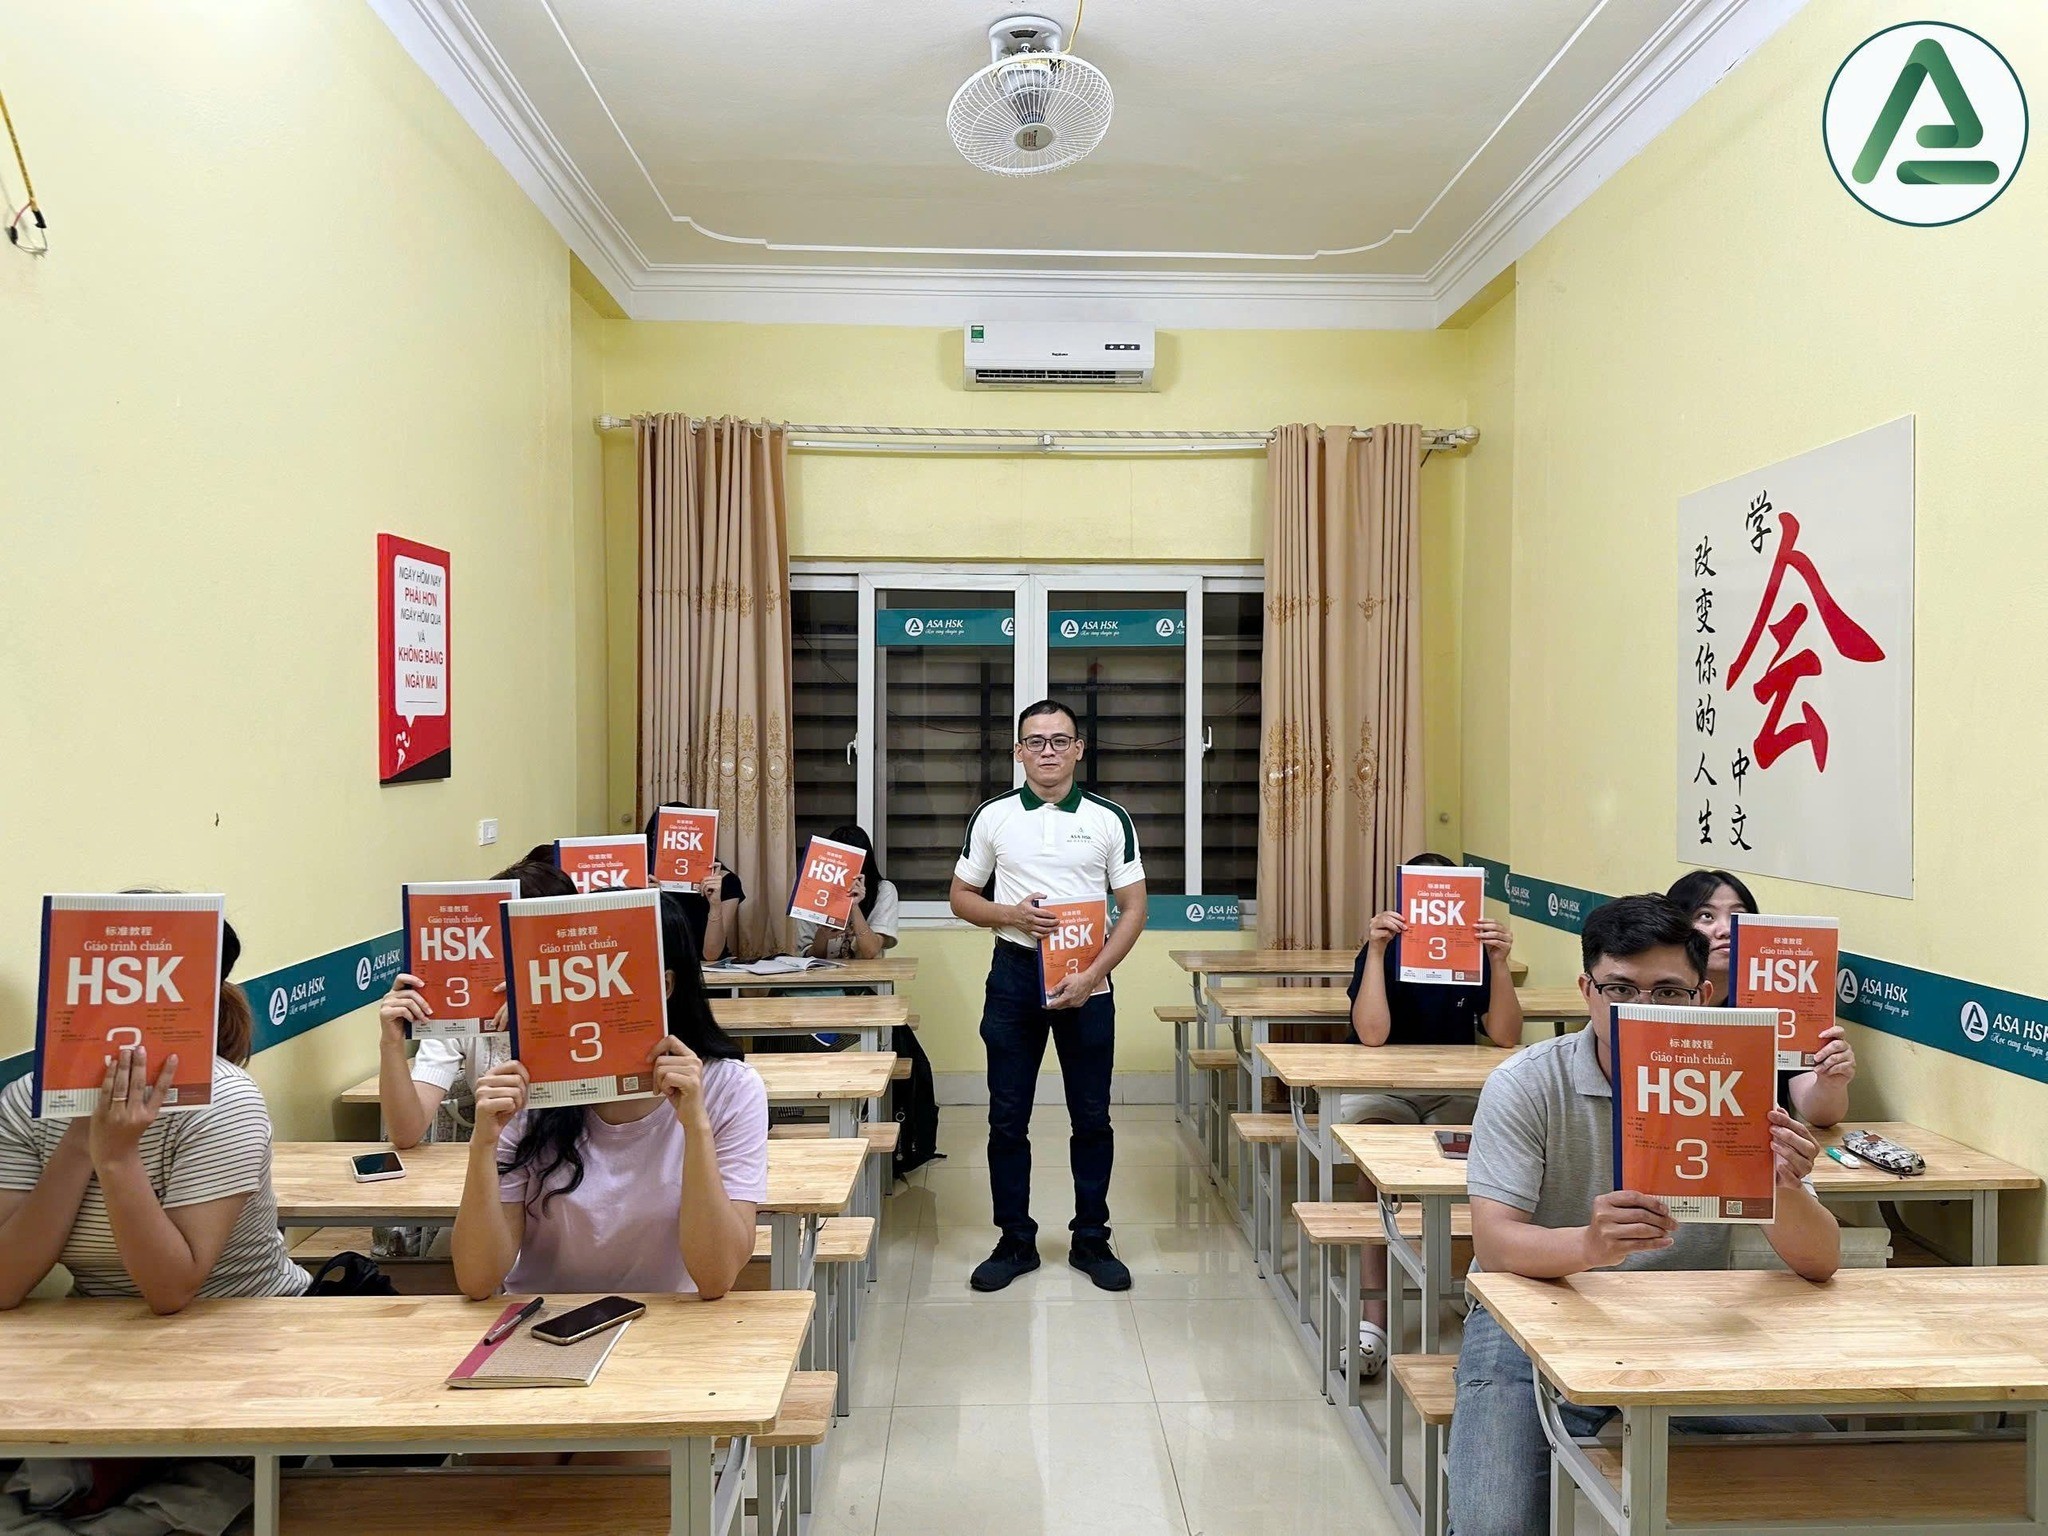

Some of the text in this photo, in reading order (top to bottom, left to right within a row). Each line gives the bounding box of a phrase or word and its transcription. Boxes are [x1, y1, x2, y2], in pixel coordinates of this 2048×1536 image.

[1745, 489, 1772, 554] 学
[416, 570, 430, 585] HÔM
[430, 574, 442, 588] NAY
[416, 610, 430, 624] HÔM
[430, 613, 441, 625] QUA
[926, 619, 964, 628] ASA HSK
[1081, 620, 1119, 630] ASA HSK
[398, 644, 424, 663] KHÔNG
[1726, 512, 1886, 773] 会
[405, 671, 438, 689] NGÀY MAI
[1694, 535, 1718, 846] 改变你的人生
[1729, 748, 1752, 851] 中文
[663, 830, 704, 852] HSK
[674, 858, 689, 876] 3
[808, 860, 850, 887] HSK
[571, 868, 630, 894] HSK
[814, 889, 830, 908] 3
[1207, 905, 1239, 915] ASA HS
[1409, 898, 1466, 926] HSK
[420, 925, 494, 962] HSK
[1049, 922, 1094, 951] HSK
[1427, 936, 1447, 961] 3
[66, 956, 185, 1005] HSK
[529, 951, 634, 1005] HSK
[1748, 957, 1820, 994] HSK
[290, 976, 325, 1003] ASA HSK
[446, 977, 471, 1007] 3
[1861, 977, 1908, 1004] ASA HSK
[1992, 1013, 2020, 1035] ASA
[569, 1021, 603, 1063] 3
[1669, 1037, 1713, 1050] 标准教程
[1650, 1050, 1733, 1065] Giáo trình chuẩn
[1637, 1066, 1745, 1117] HSK
[1675, 1138, 1709, 1180] 3
